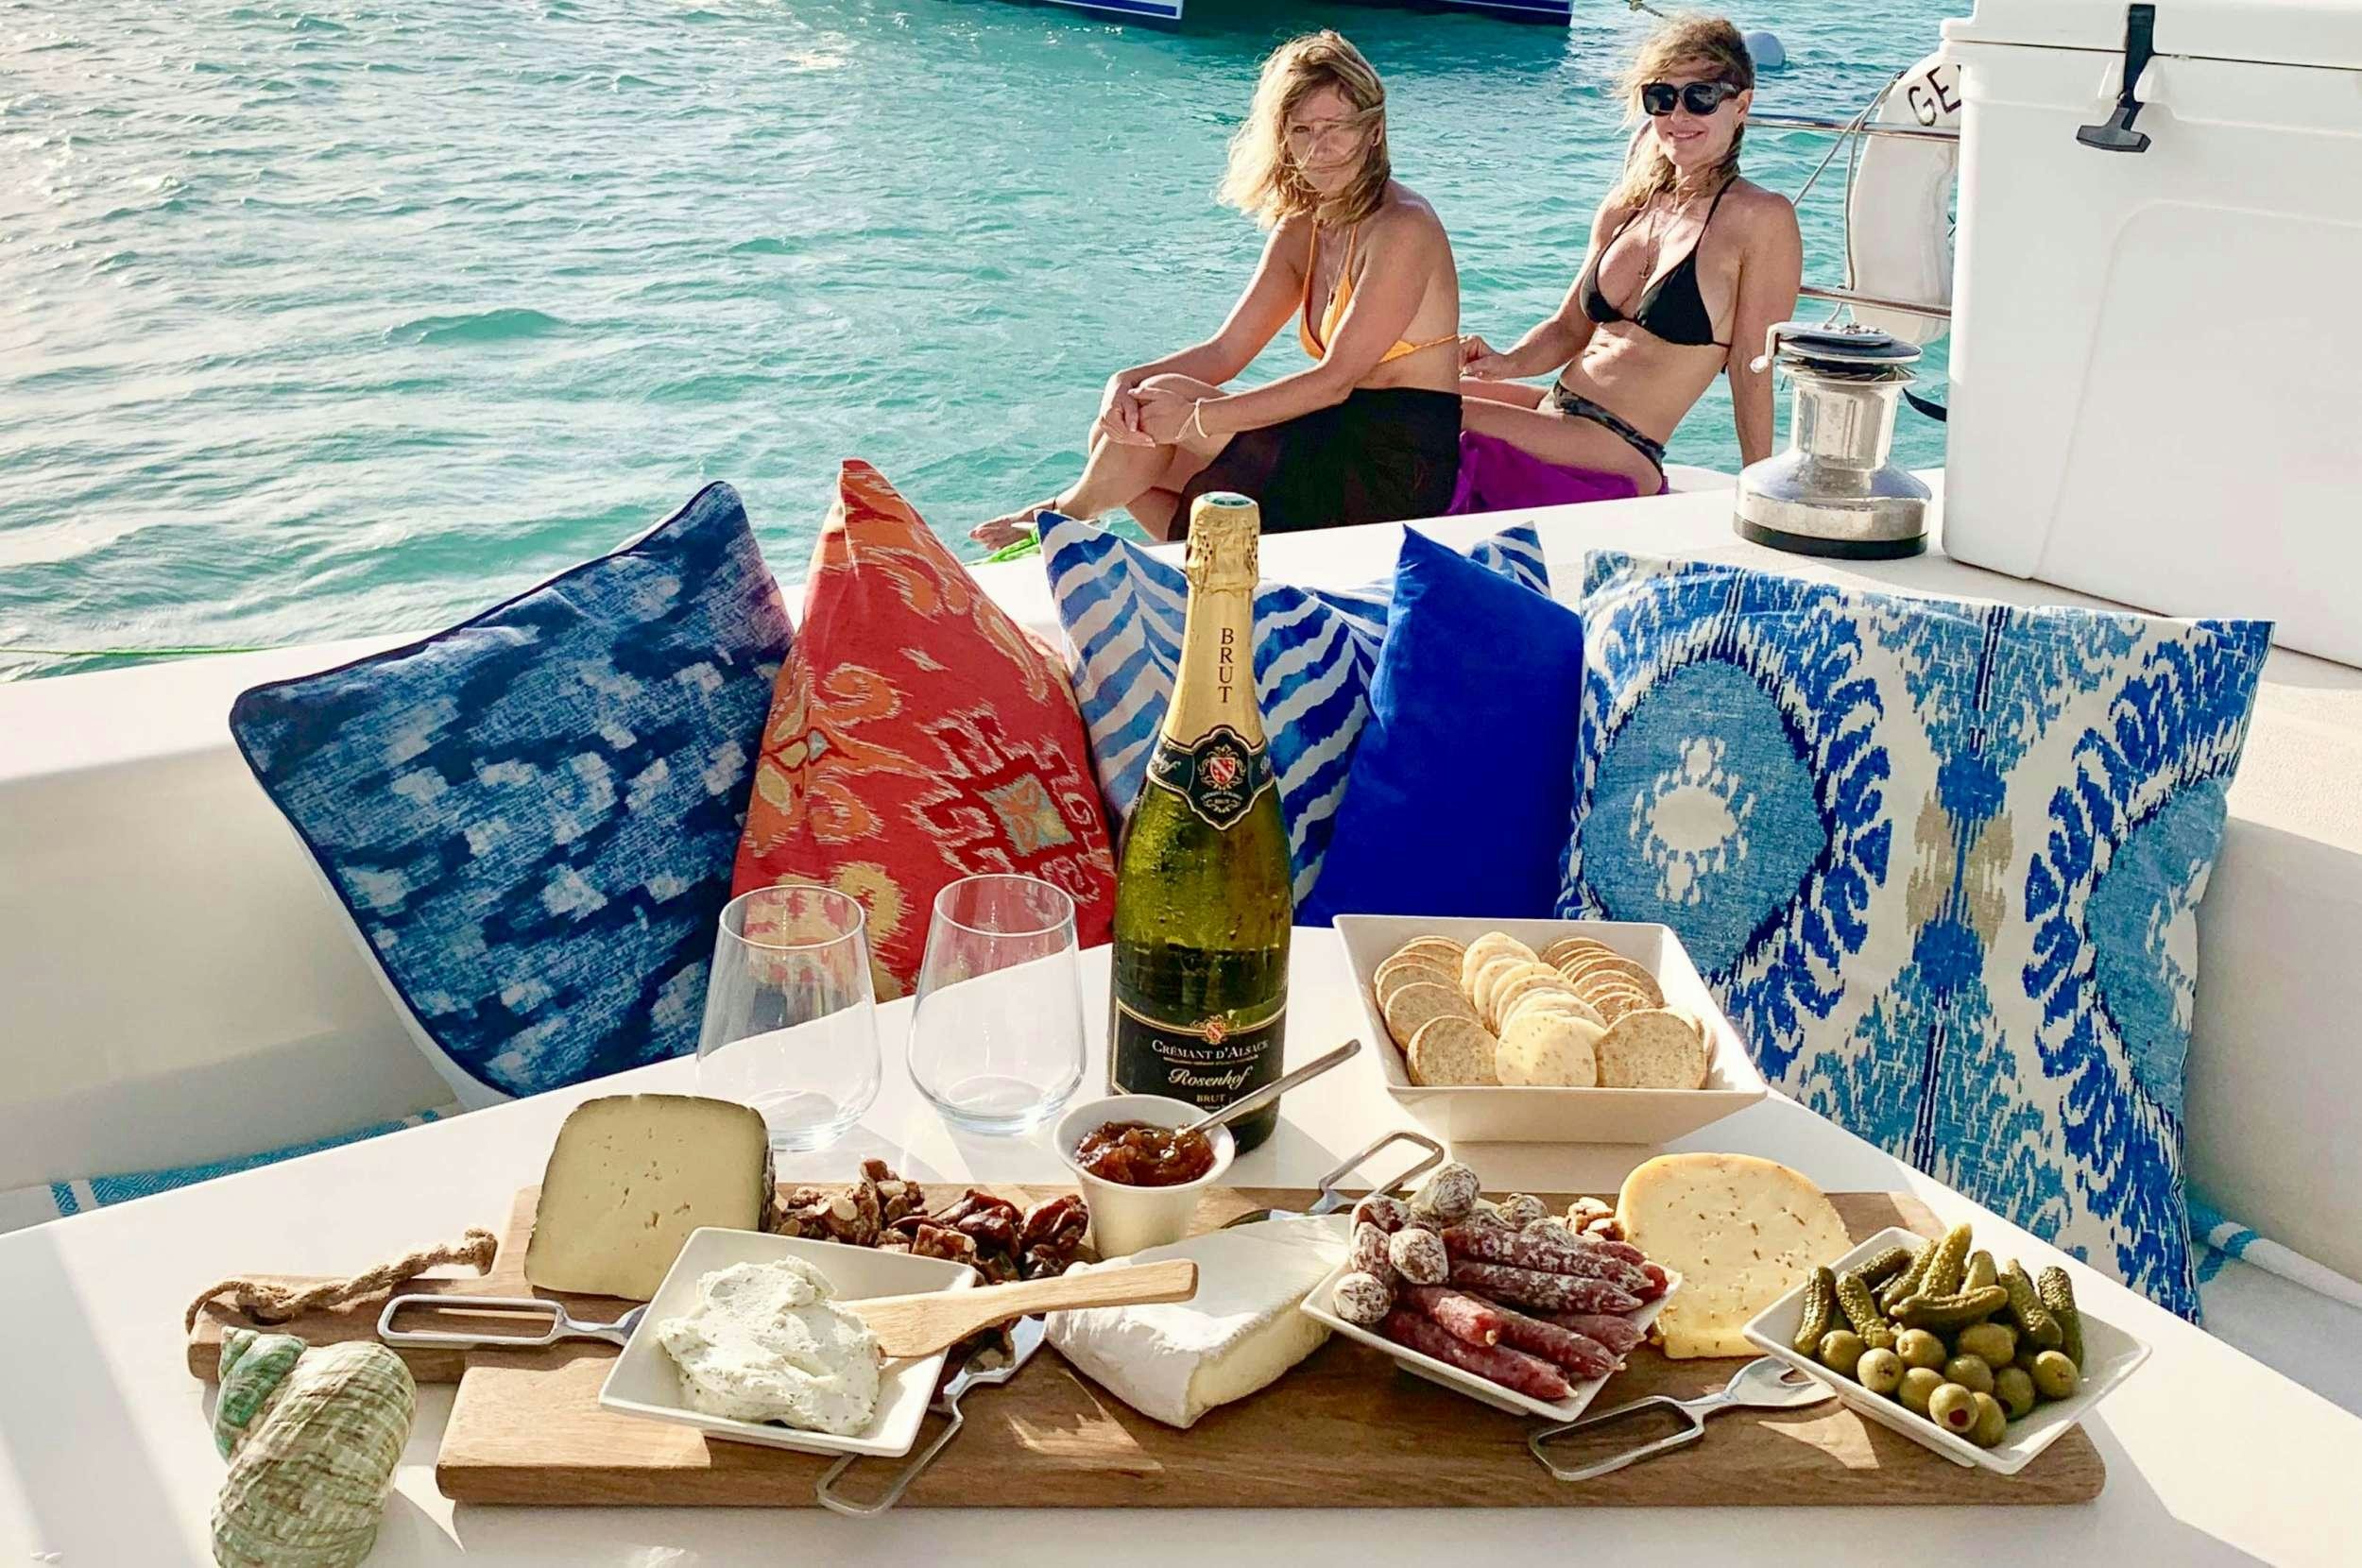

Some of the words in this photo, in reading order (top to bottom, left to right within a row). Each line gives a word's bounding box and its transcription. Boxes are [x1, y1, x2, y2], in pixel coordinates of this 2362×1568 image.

[1908, 64, 1962, 127] GE
[1218, 627, 1235, 703] BRUT
[1168, 1065, 1254, 1090] Rosenhof
[1196, 1094, 1226, 1103] BRUT
